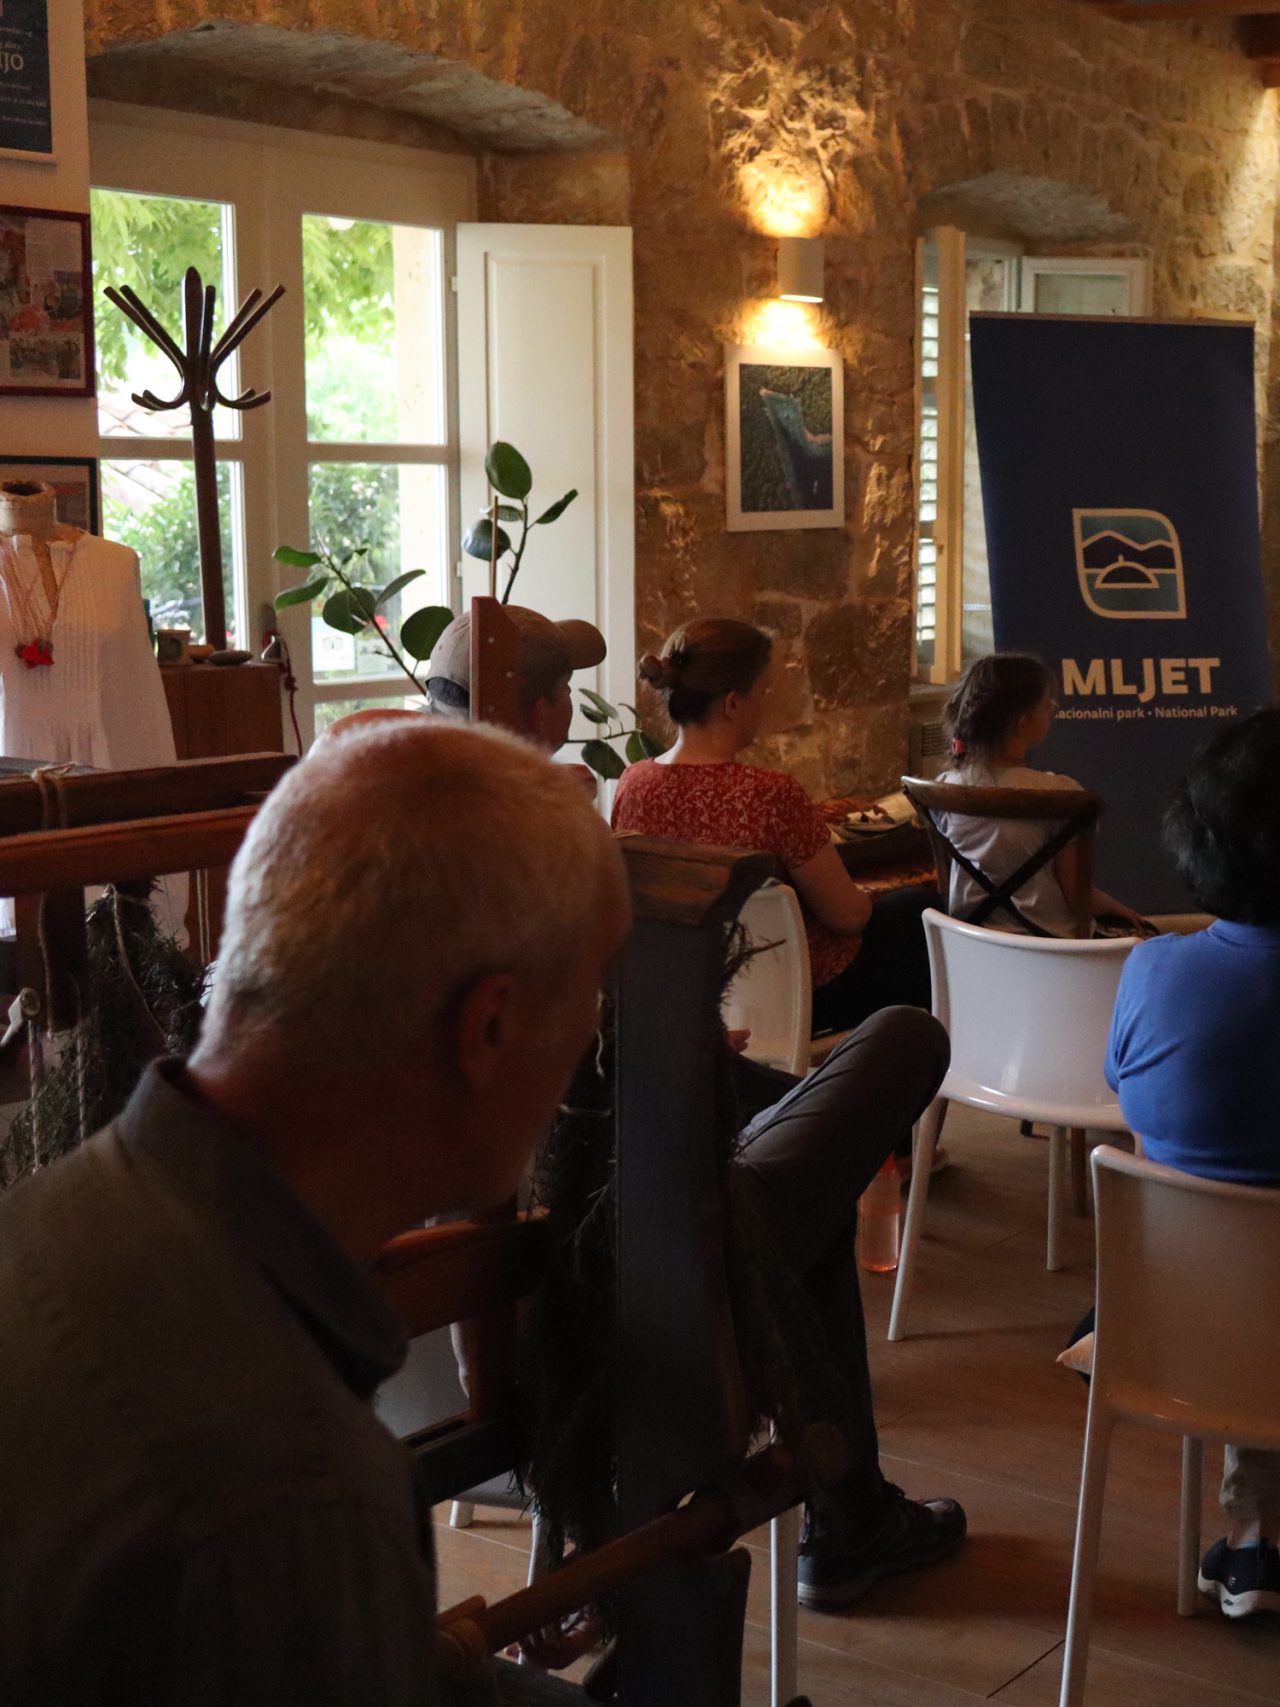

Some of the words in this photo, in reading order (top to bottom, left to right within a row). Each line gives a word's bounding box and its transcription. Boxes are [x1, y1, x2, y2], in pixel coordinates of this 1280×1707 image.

[1061, 657, 1221, 703] MLJET
[1117, 706, 1144, 721] park
[1155, 705, 1207, 718] National
[1210, 705, 1238, 717] Park
